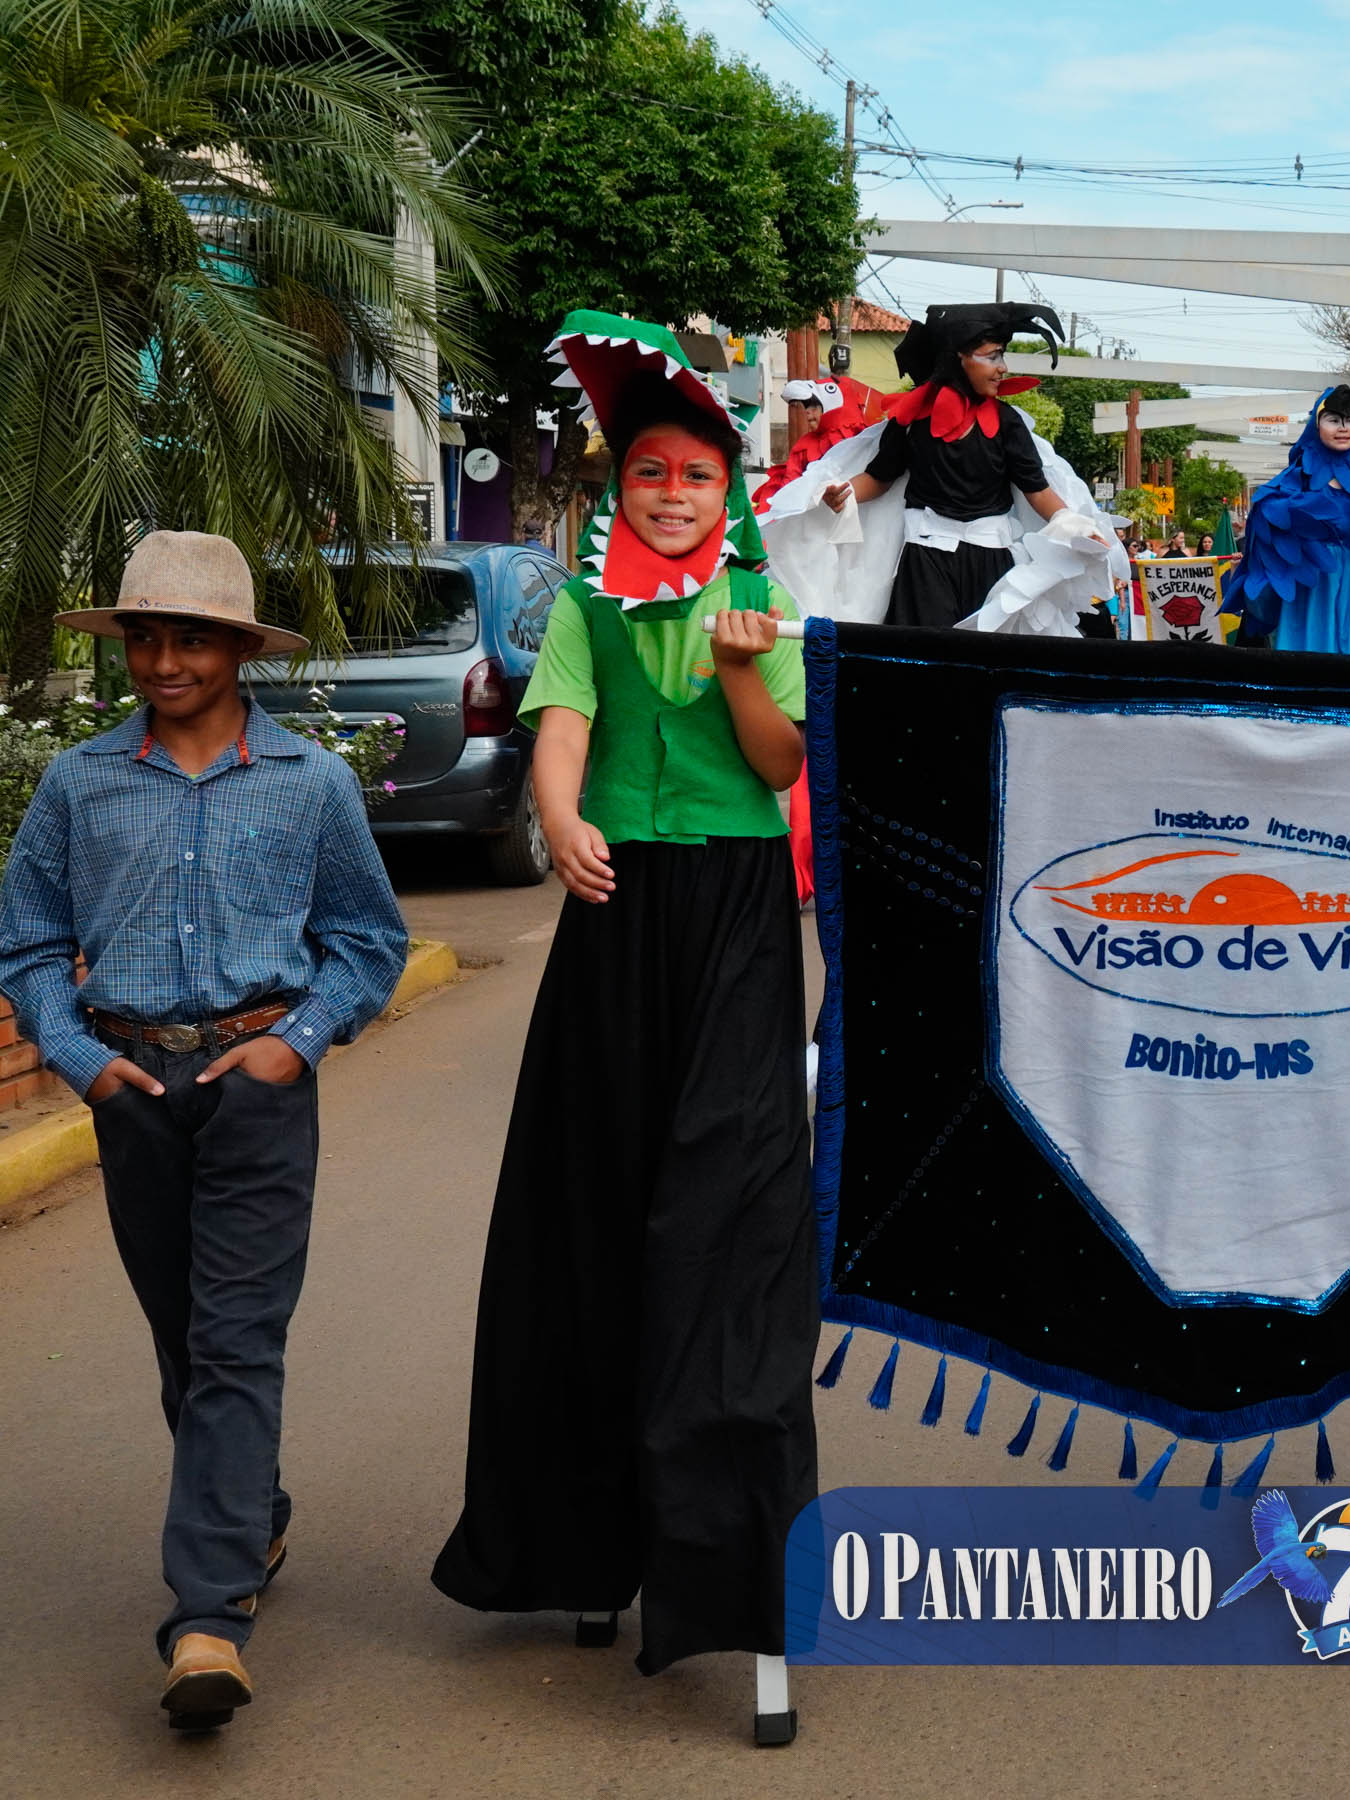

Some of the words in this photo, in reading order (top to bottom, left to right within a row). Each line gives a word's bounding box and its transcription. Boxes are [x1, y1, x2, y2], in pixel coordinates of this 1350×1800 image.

[1253, 415, 1286, 423] ATENÇÃO
[1169, 566, 1214, 579] CAMINHO
[1148, 590, 1160, 602] DA
[1156, 581, 1217, 602] ESPERANÇA
[1154, 808, 1250, 831] Instituto
[1053, 924, 1204, 971] Visão
[1217, 924, 1289, 971] de
